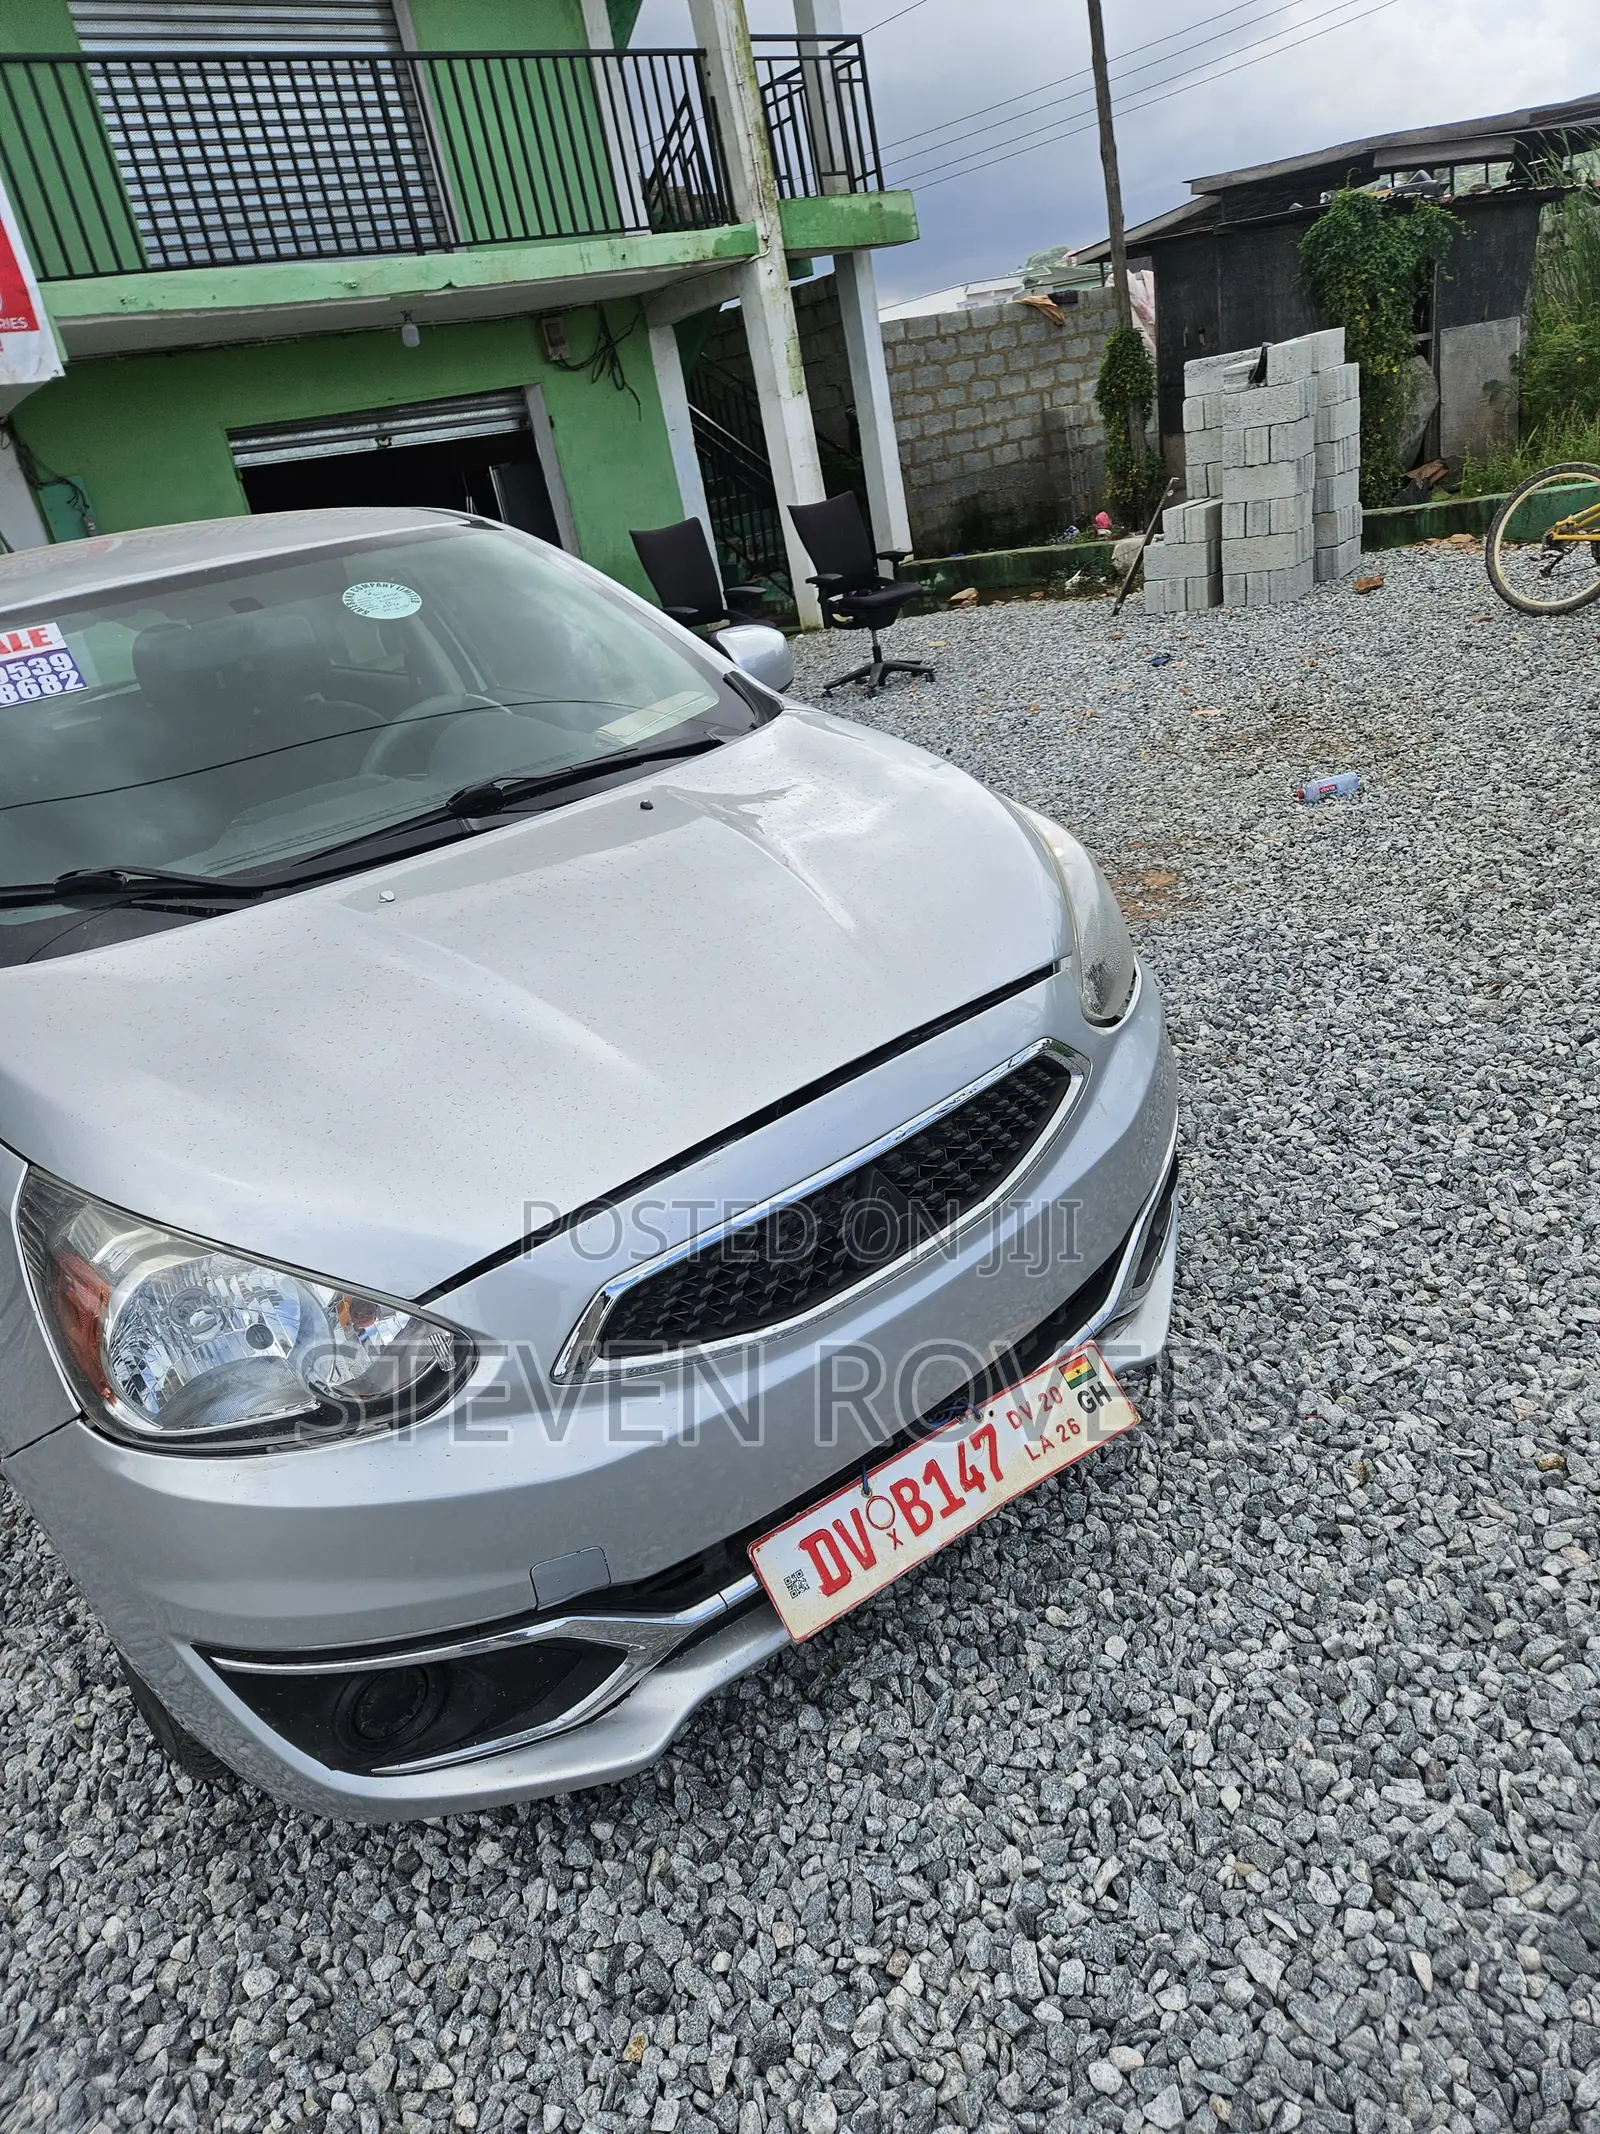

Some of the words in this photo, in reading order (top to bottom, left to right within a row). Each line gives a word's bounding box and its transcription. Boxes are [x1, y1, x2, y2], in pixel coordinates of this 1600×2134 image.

[350, 583, 395, 593] COMPANY
[396, 586, 420, 603] LIMITED
[1005, 1401, 1033, 1430] DV
[1037, 1385, 1064, 1412] 20
[1076, 1381, 1113, 1415] GH
[1024, 1435, 1055, 1461] LA
[1055, 1417, 1081, 1443] 26
[799, 1507, 877, 1598] DV
[889, 1423, 1004, 1537] B147
